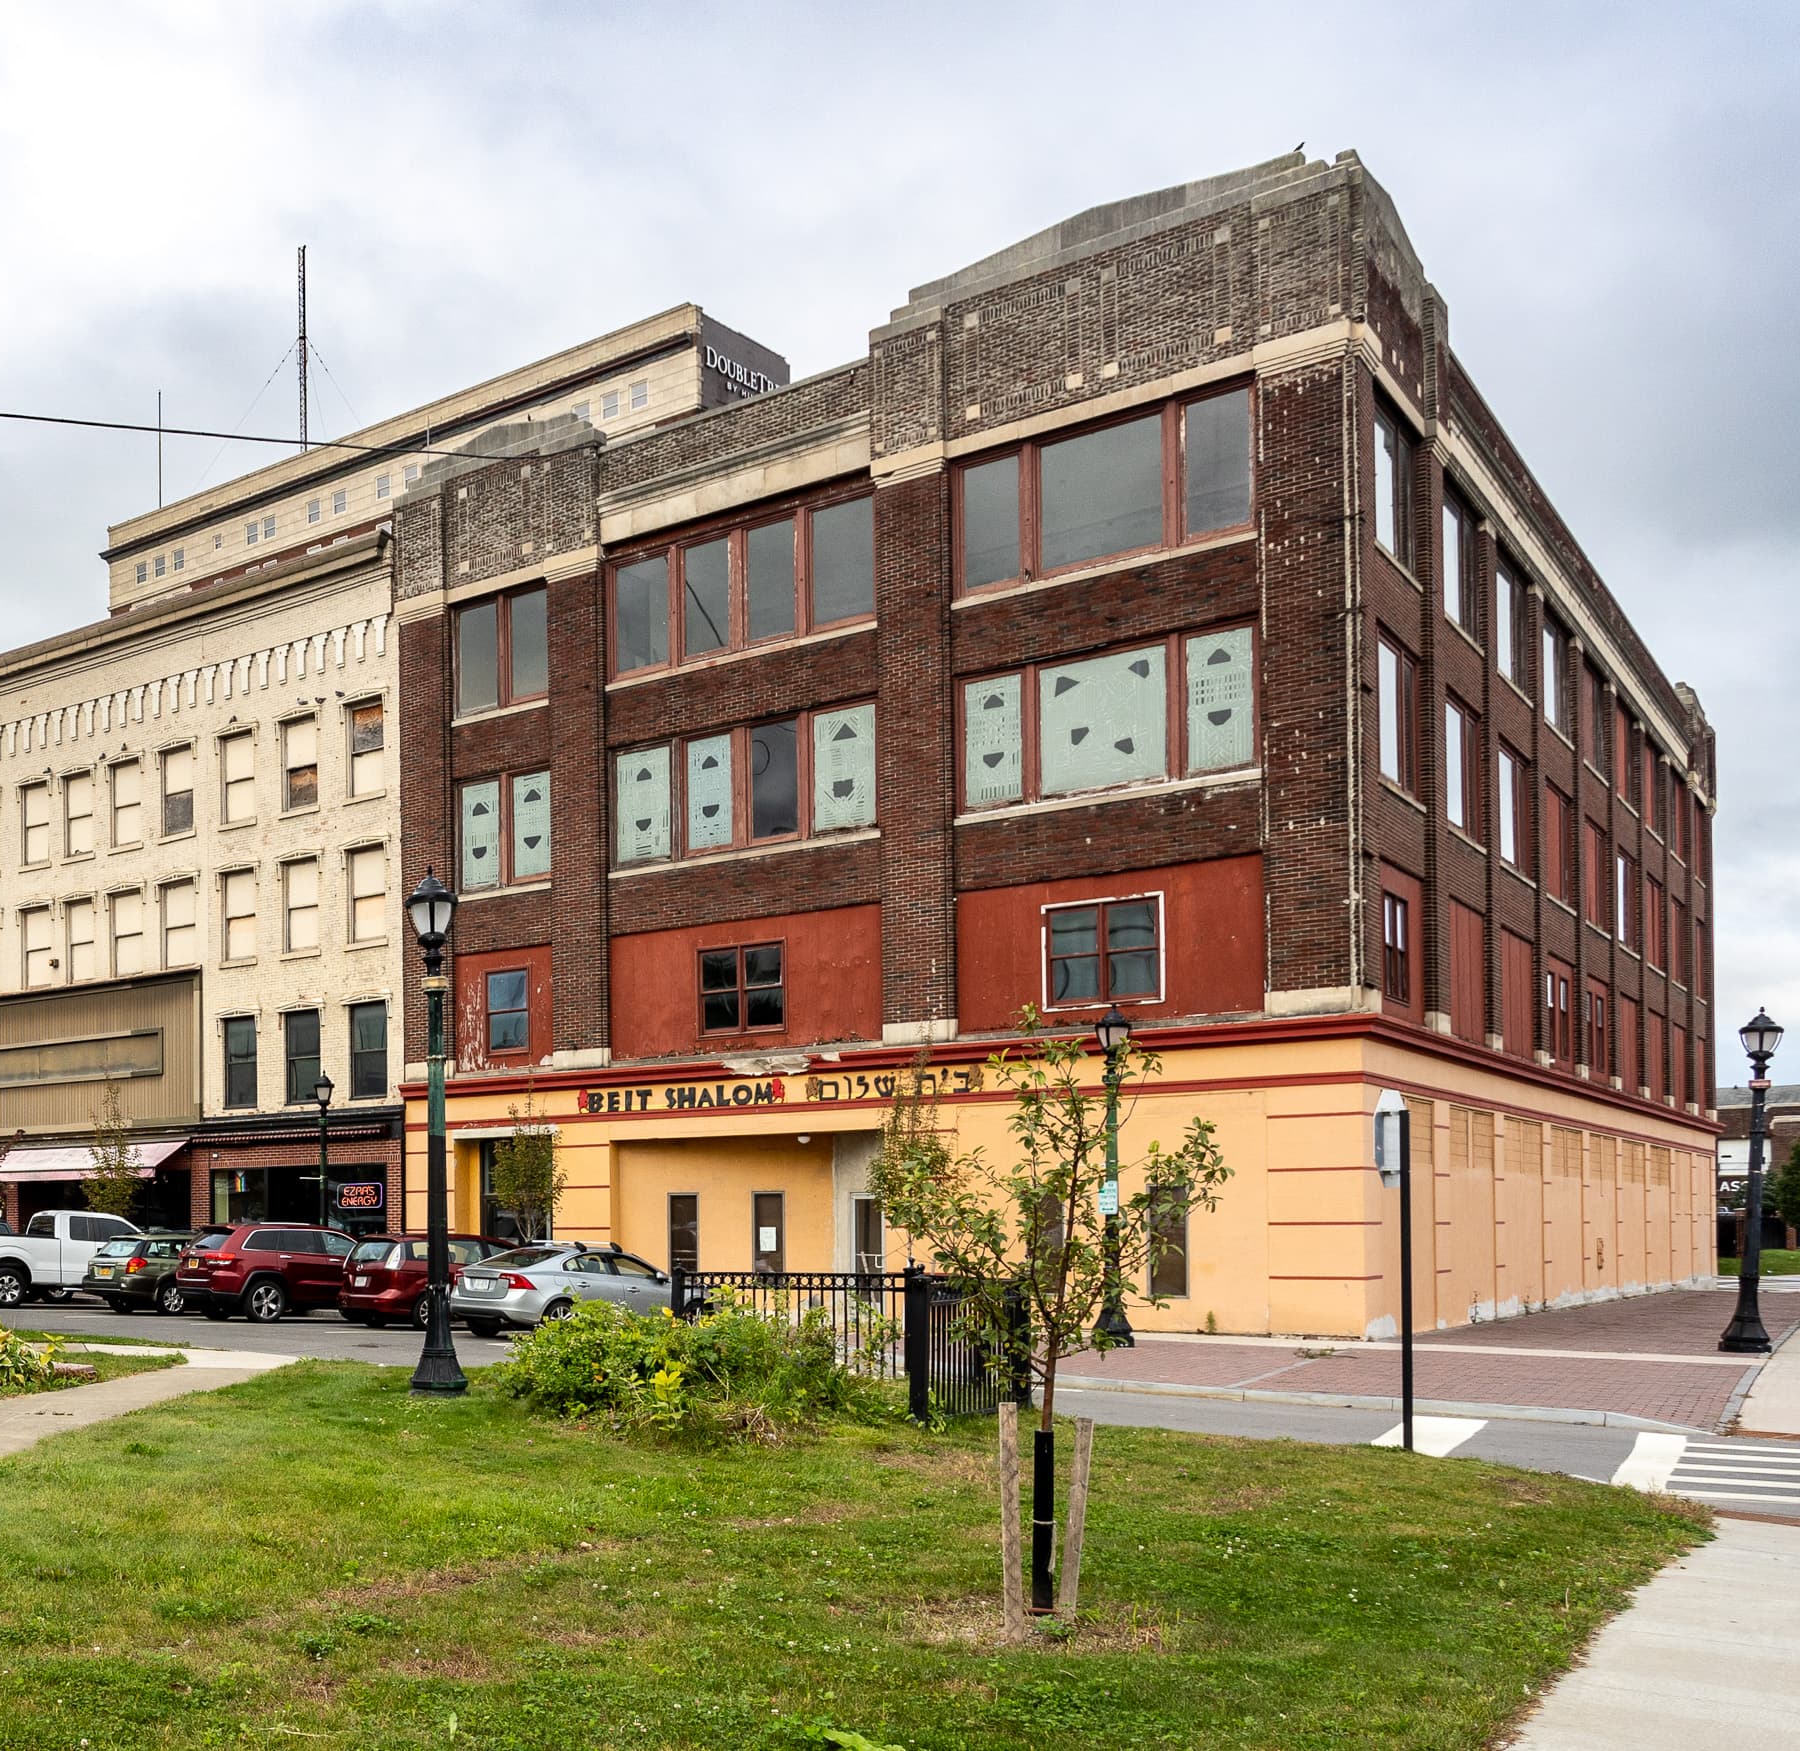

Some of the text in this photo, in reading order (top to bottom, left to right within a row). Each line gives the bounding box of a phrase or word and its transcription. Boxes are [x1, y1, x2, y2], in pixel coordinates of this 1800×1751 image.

[727, 381, 753, 398] BY HI
[587, 1080, 774, 1113] BEIT SHALOM
[343, 1185, 376, 1196] EZRA'S
[341, 1195, 378, 1207] ENERGY
